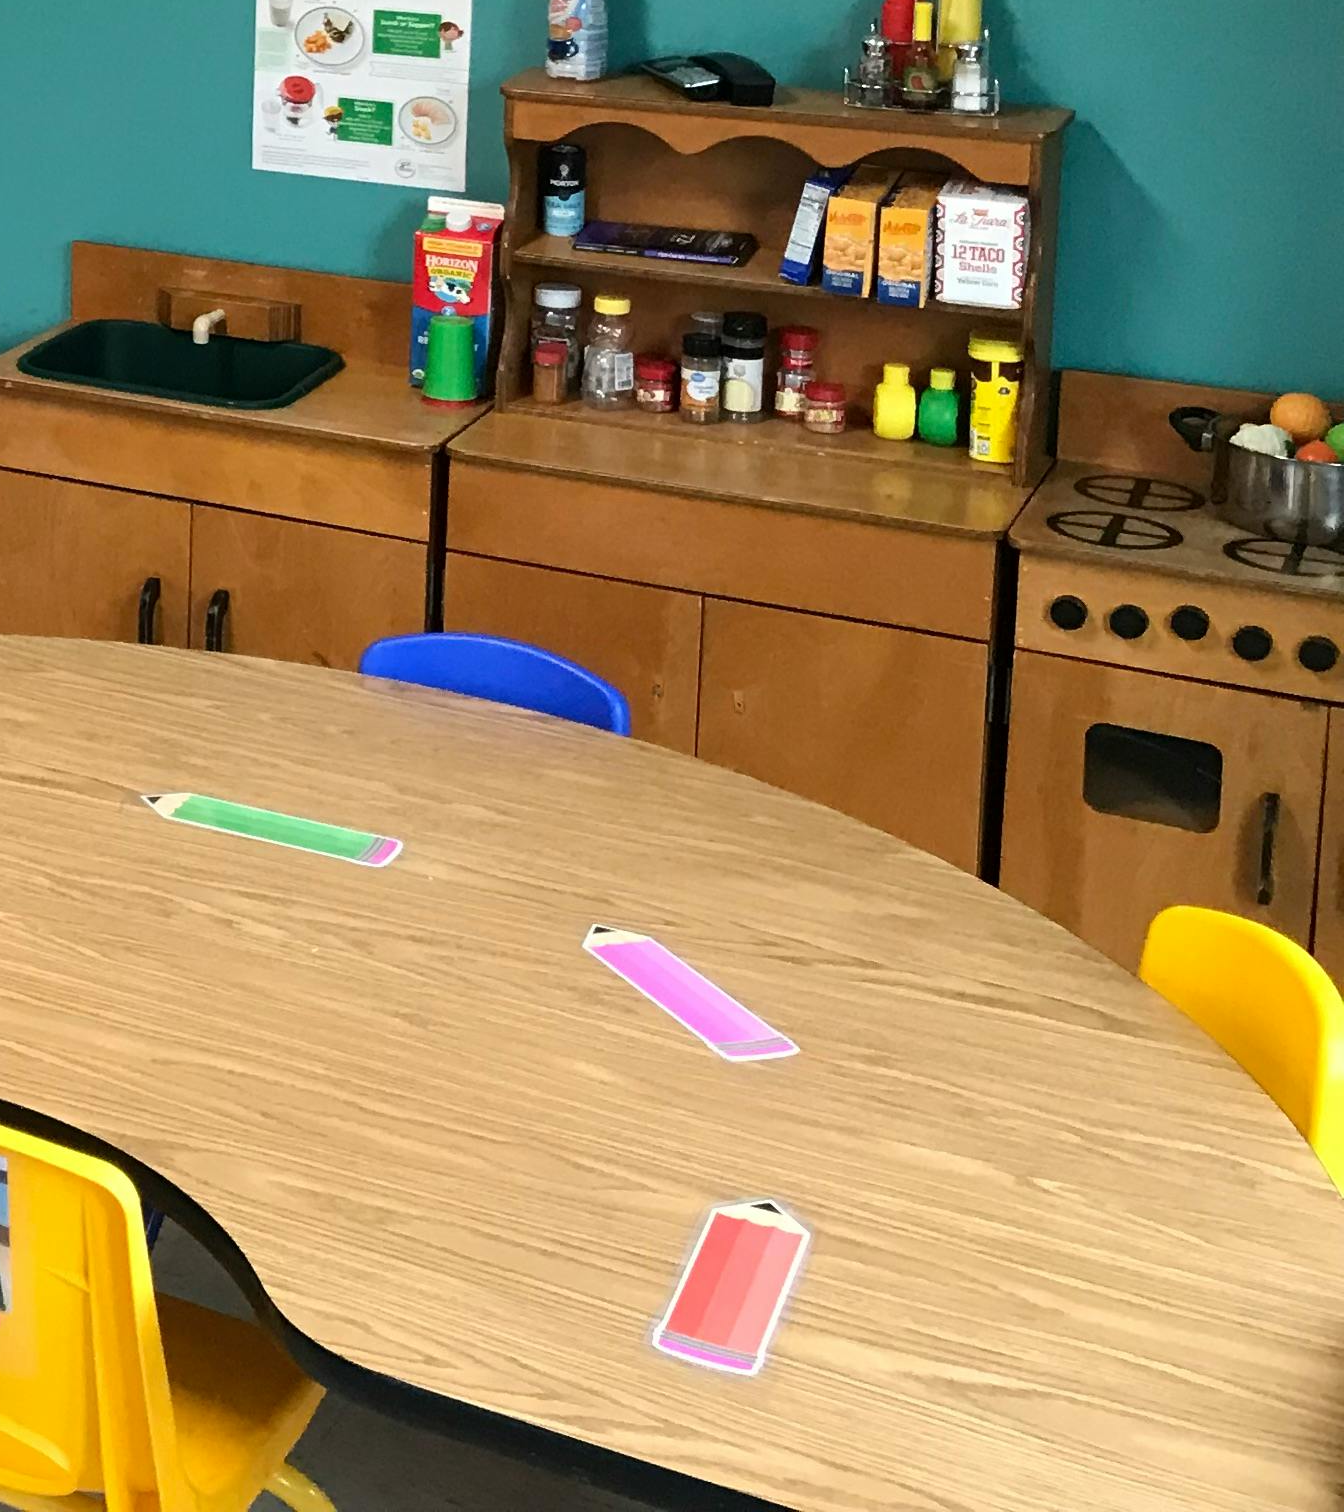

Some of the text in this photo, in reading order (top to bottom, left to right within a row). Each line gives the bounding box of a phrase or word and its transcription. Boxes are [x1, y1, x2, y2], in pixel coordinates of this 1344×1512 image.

[951, 243, 1005, 263] 12 TACO
[425, 254, 478, 272] HORIZON
[958, 262, 997, 274] Shells
[430, 268, 472, 279] ORGANIC
